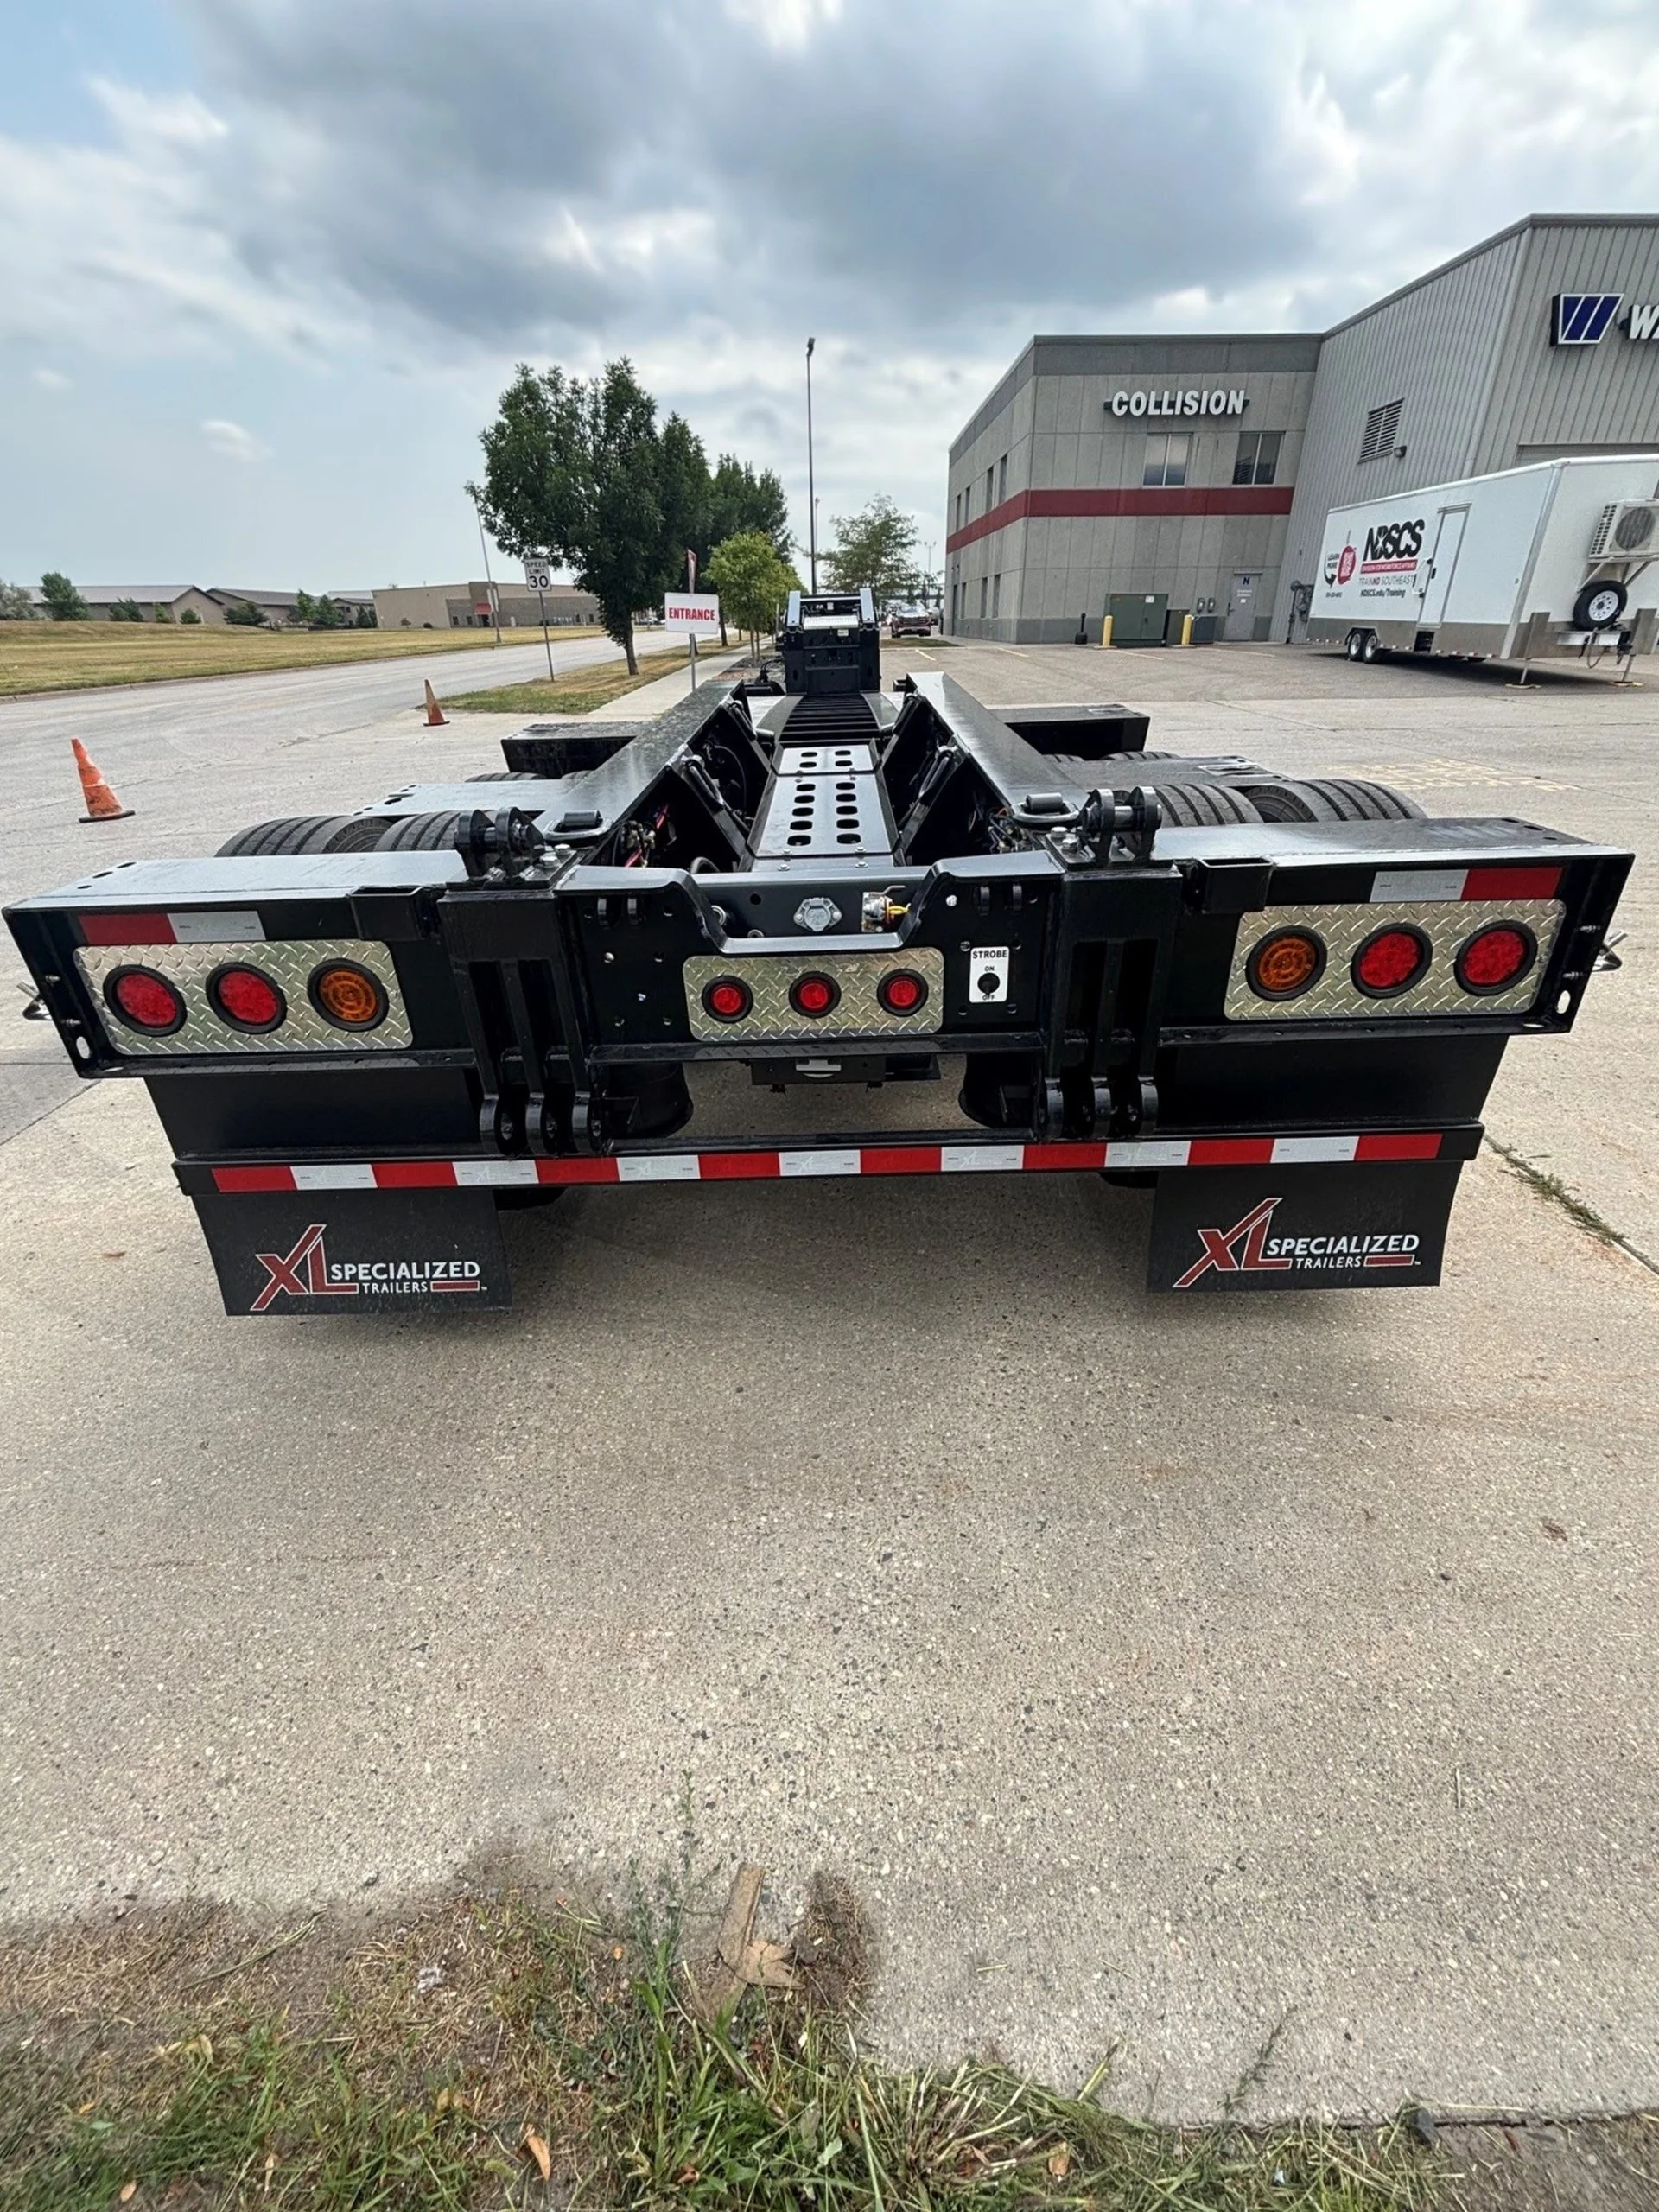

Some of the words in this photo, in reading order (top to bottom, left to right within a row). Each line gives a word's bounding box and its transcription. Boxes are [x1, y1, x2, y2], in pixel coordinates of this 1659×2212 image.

[1629, 304, 1659, 340] W
[1112, 389, 1245, 416] COLLISION
[529, 575, 549, 588] 30
[1243, 576, 1251, 585] N
[669, 607, 715, 621] ENTRANCE
[972, 950, 1007, 959] STROBE
[1172, 1198, 1293, 1287] XL
[1267, 1234, 1420, 1255] SPECIALIZED
[250, 1224, 359, 1311] XL
[331, 1261, 480, 1281] SPECIALIZED
[1295, 1255, 1362, 1269] TRAILERS
[362, 1281, 429, 1294] TRAILERS
